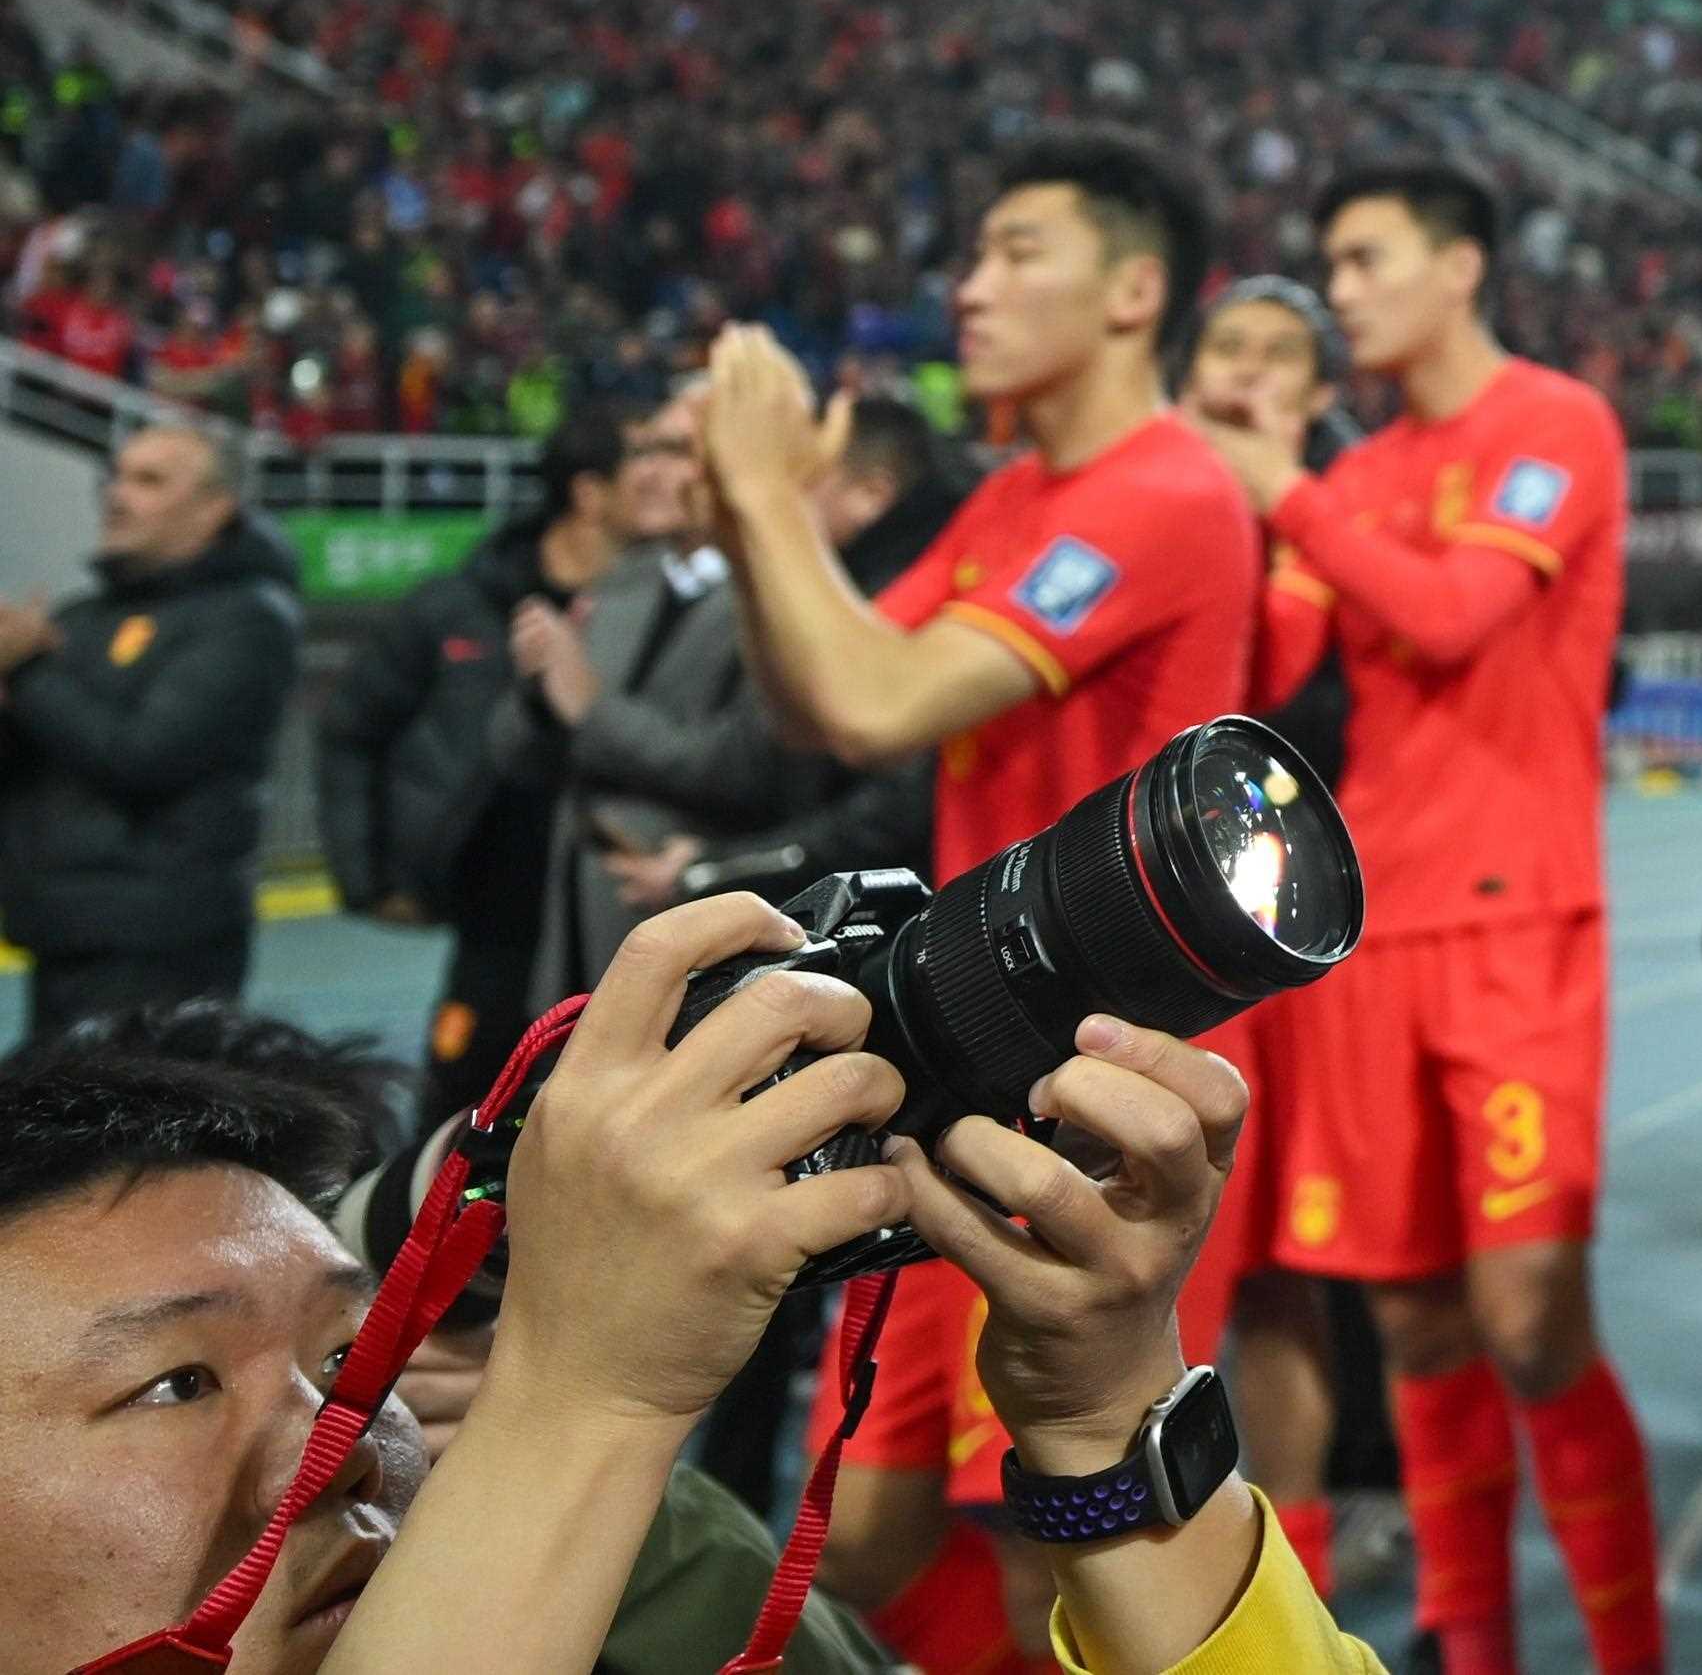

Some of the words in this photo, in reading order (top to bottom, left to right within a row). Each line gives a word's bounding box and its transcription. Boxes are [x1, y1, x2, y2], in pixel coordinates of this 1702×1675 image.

[834, 924, 885, 939] Canon
[917, 948, 928, 964] 70
[1000, 945, 1016, 972] LOCK
[1482, 1082, 1546, 1181] 3
